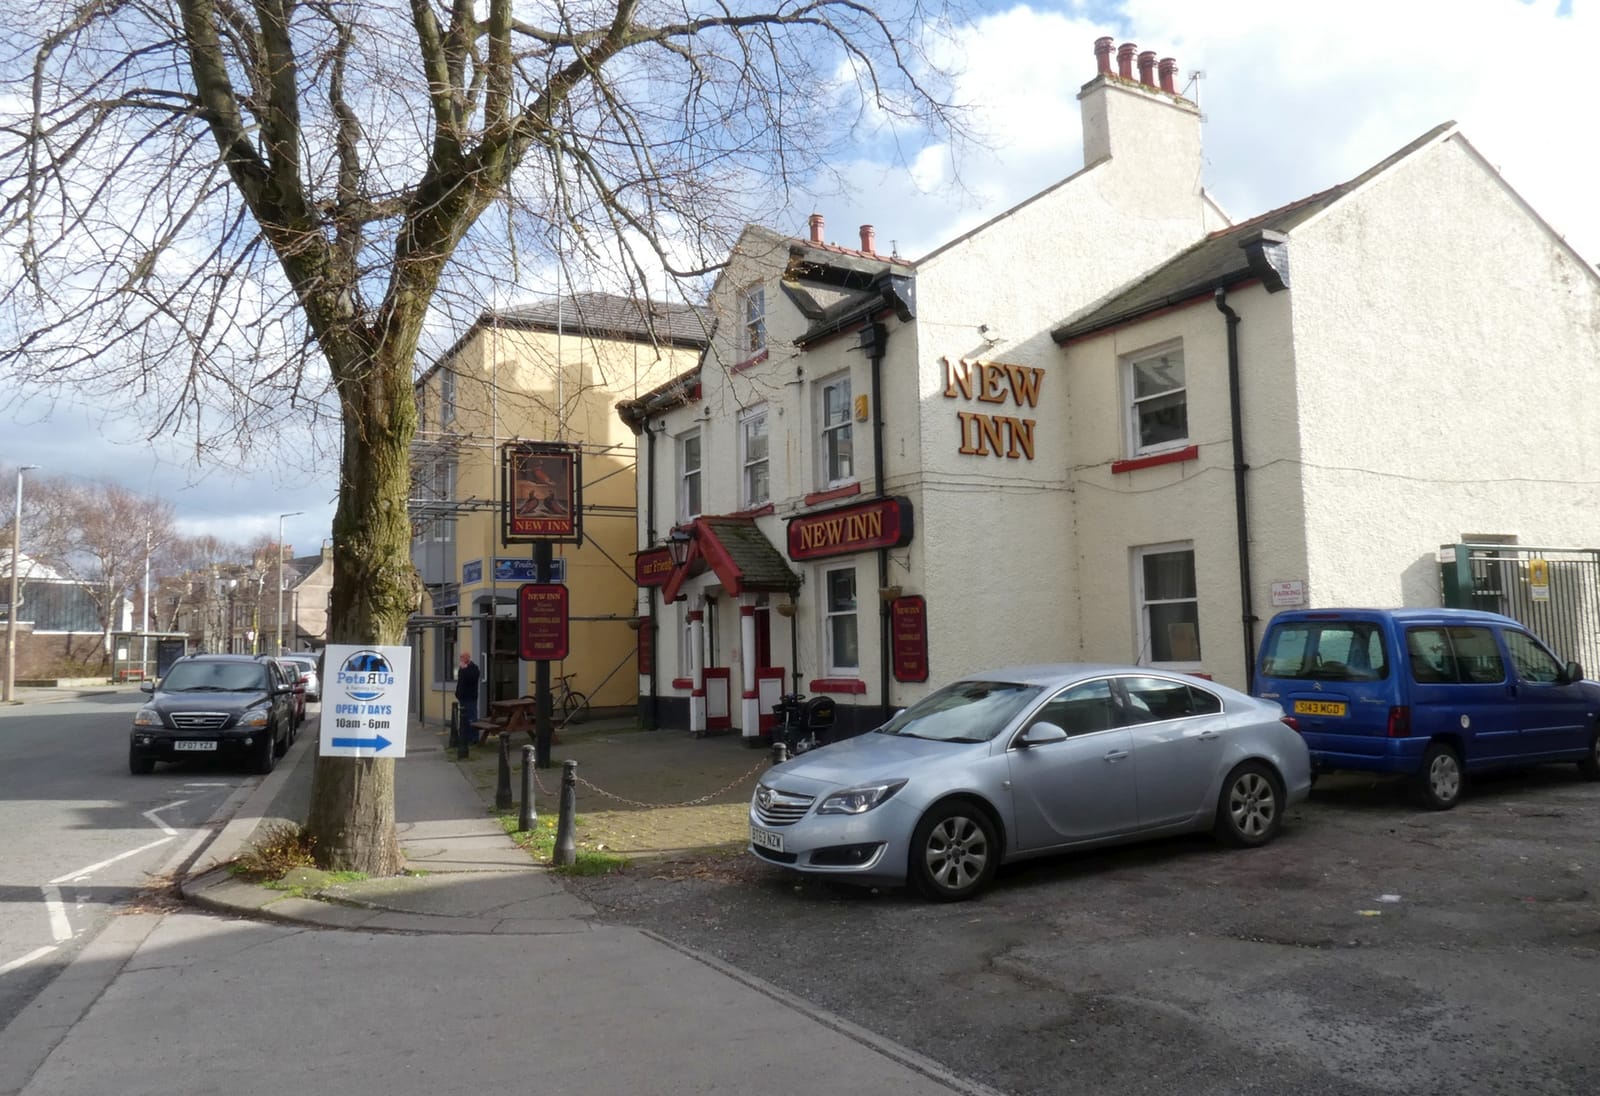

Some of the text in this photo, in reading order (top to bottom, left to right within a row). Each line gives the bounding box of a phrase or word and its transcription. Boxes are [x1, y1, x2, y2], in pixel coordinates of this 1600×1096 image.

[942, 355, 1046, 408] NEW
[957, 411, 1037, 460] INN
[515, 521, 571, 531] NEW INN
[799, 510, 883, 550] NEW INN
[336, 672, 365, 684] Pets
[378, 672, 394, 685] Us
[335, 703, 392, 715] OPEN 7 DAYS
[1299, 702, 1318, 713] S143
[336, 718, 360, 729] 10am
[368, 718, 390, 730] 6pm
